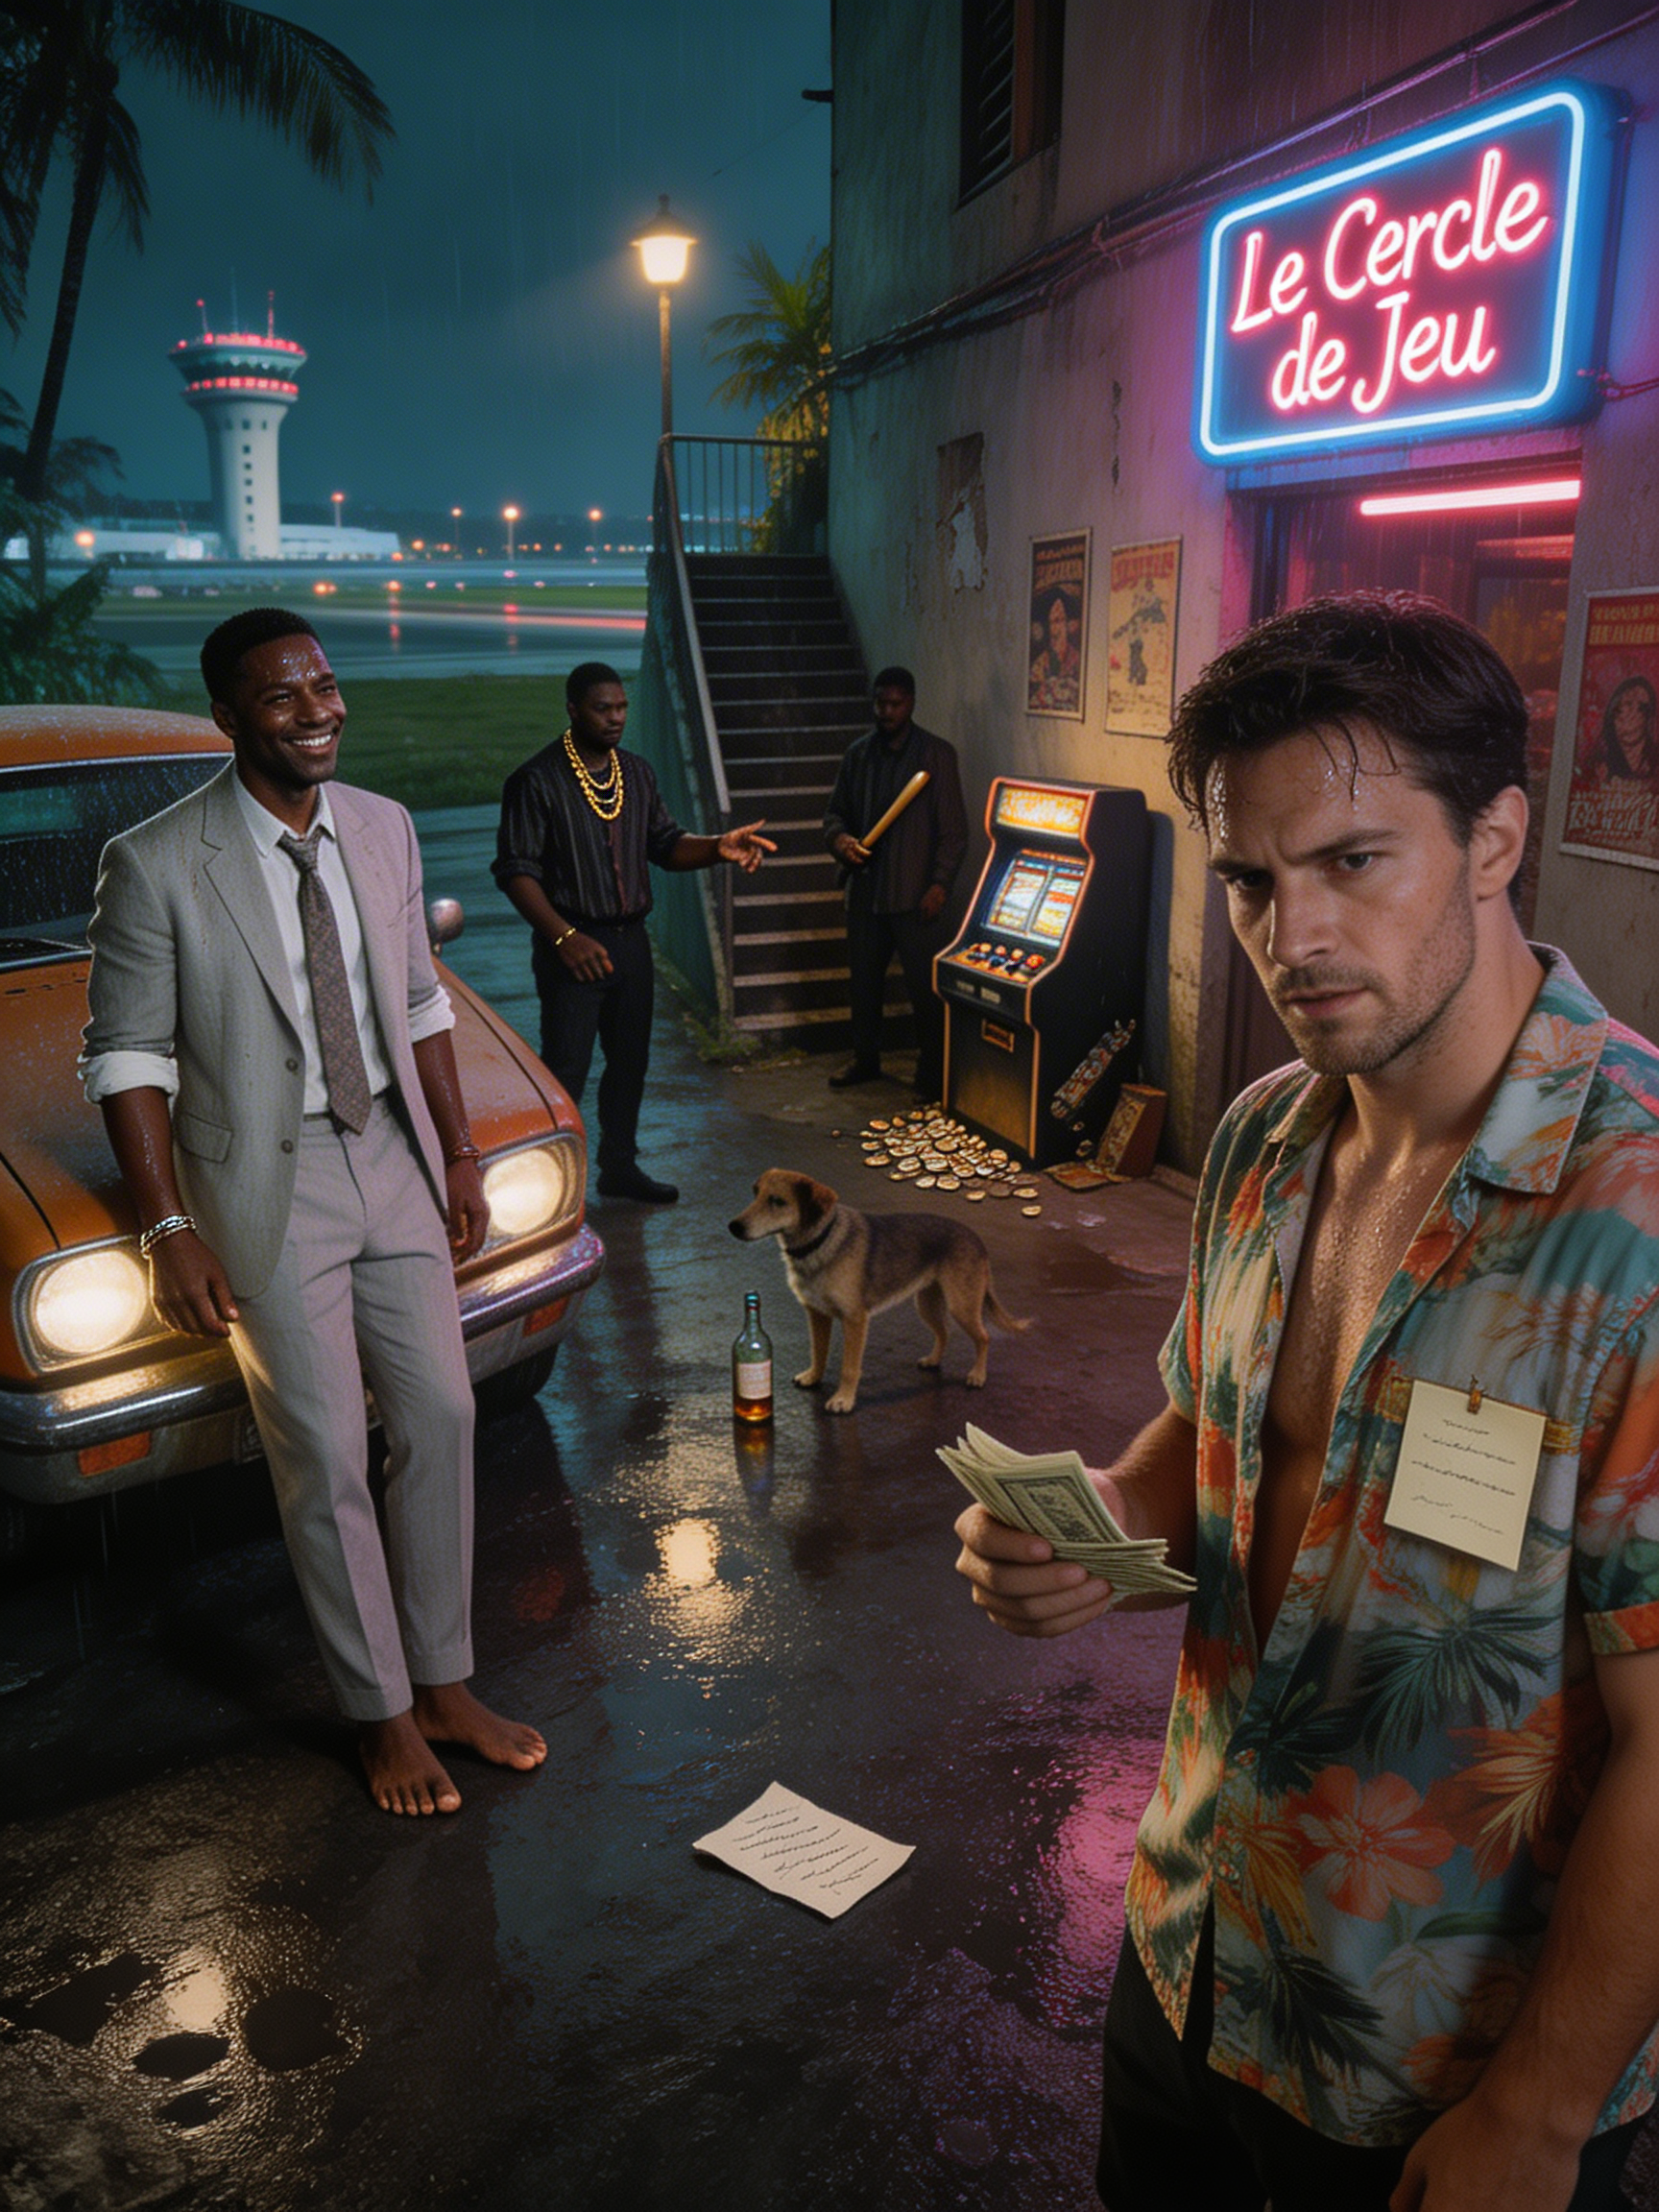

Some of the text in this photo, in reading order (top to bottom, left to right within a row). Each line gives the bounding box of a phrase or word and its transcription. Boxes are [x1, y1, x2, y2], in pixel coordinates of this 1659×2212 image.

[1232, 148, 1548, 332] Le Cercle
[1271, 292, 1495, 413] de Jeu
